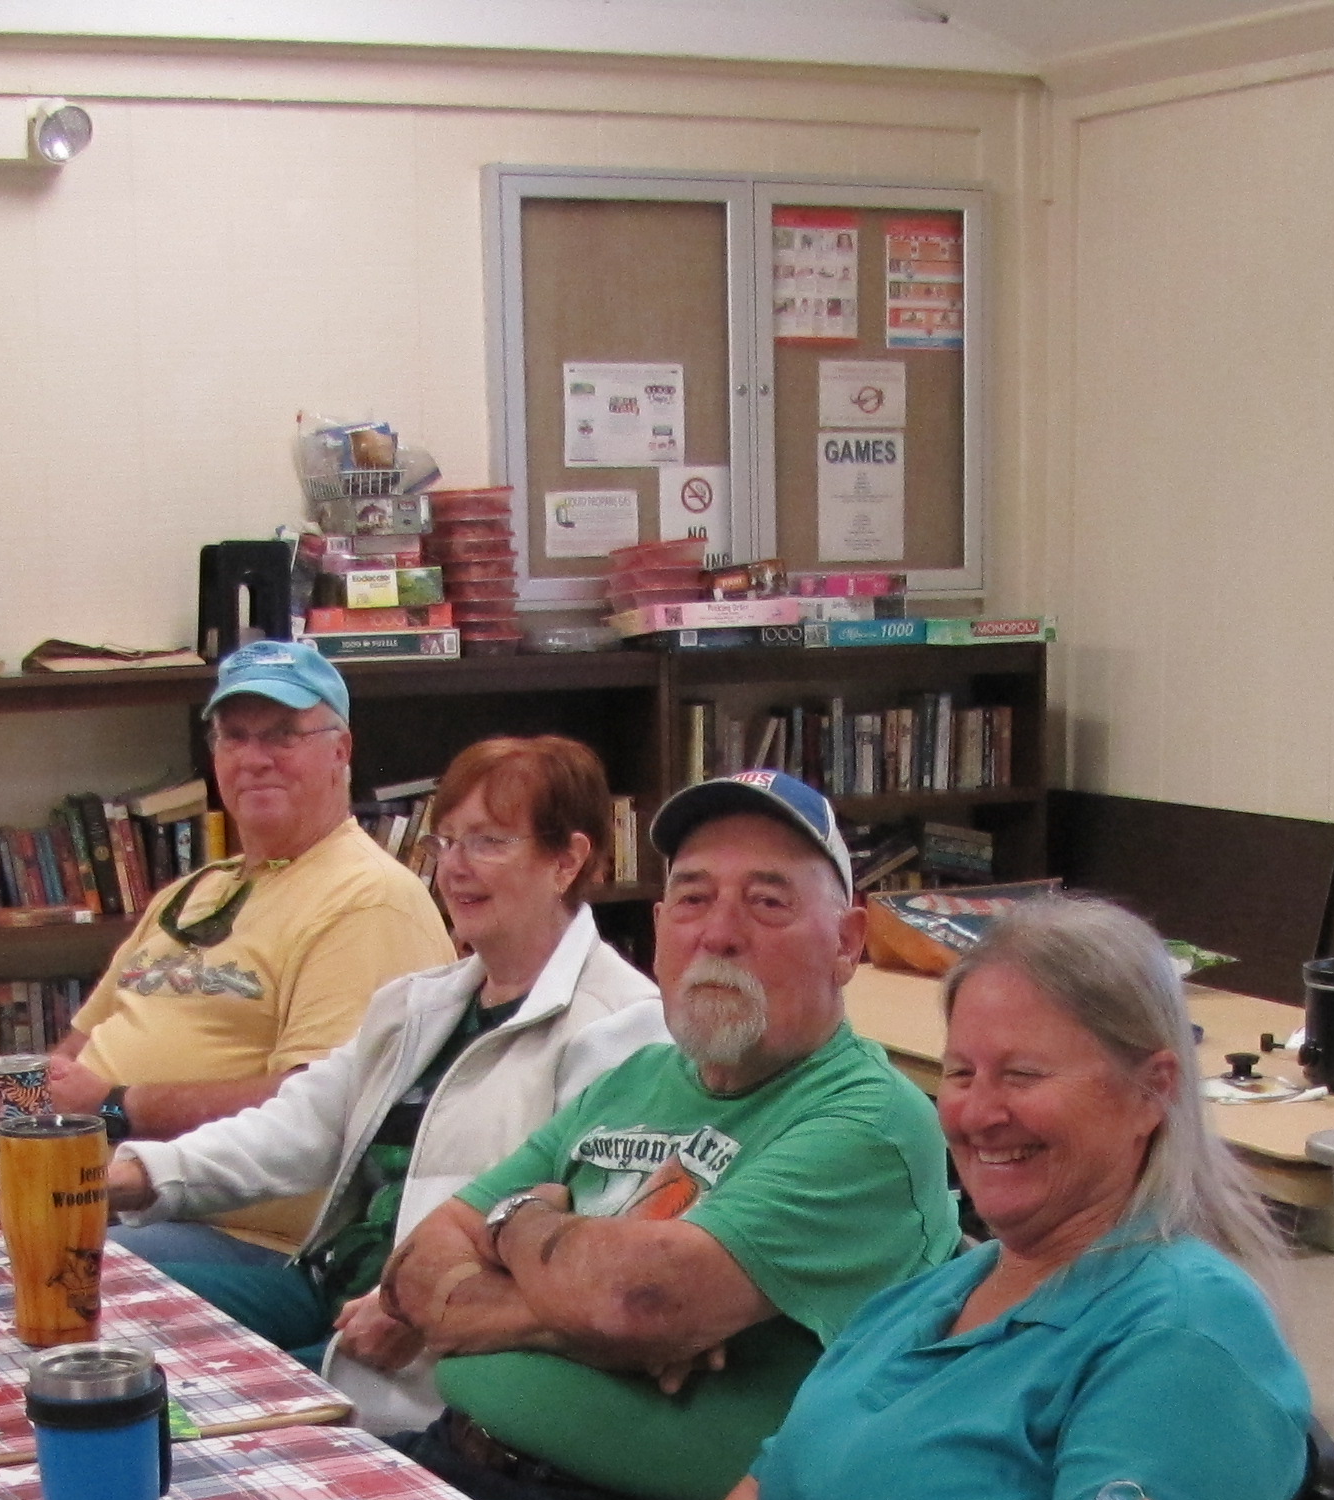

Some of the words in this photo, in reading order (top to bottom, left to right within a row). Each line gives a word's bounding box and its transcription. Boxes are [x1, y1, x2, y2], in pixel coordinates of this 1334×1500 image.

[824, 439, 897, 464] GAMES
[761, 626, 803, 642] 1000
[880, 622, 914, 638] 1000
[977, 621, 1037, 635] MONOPOLY
